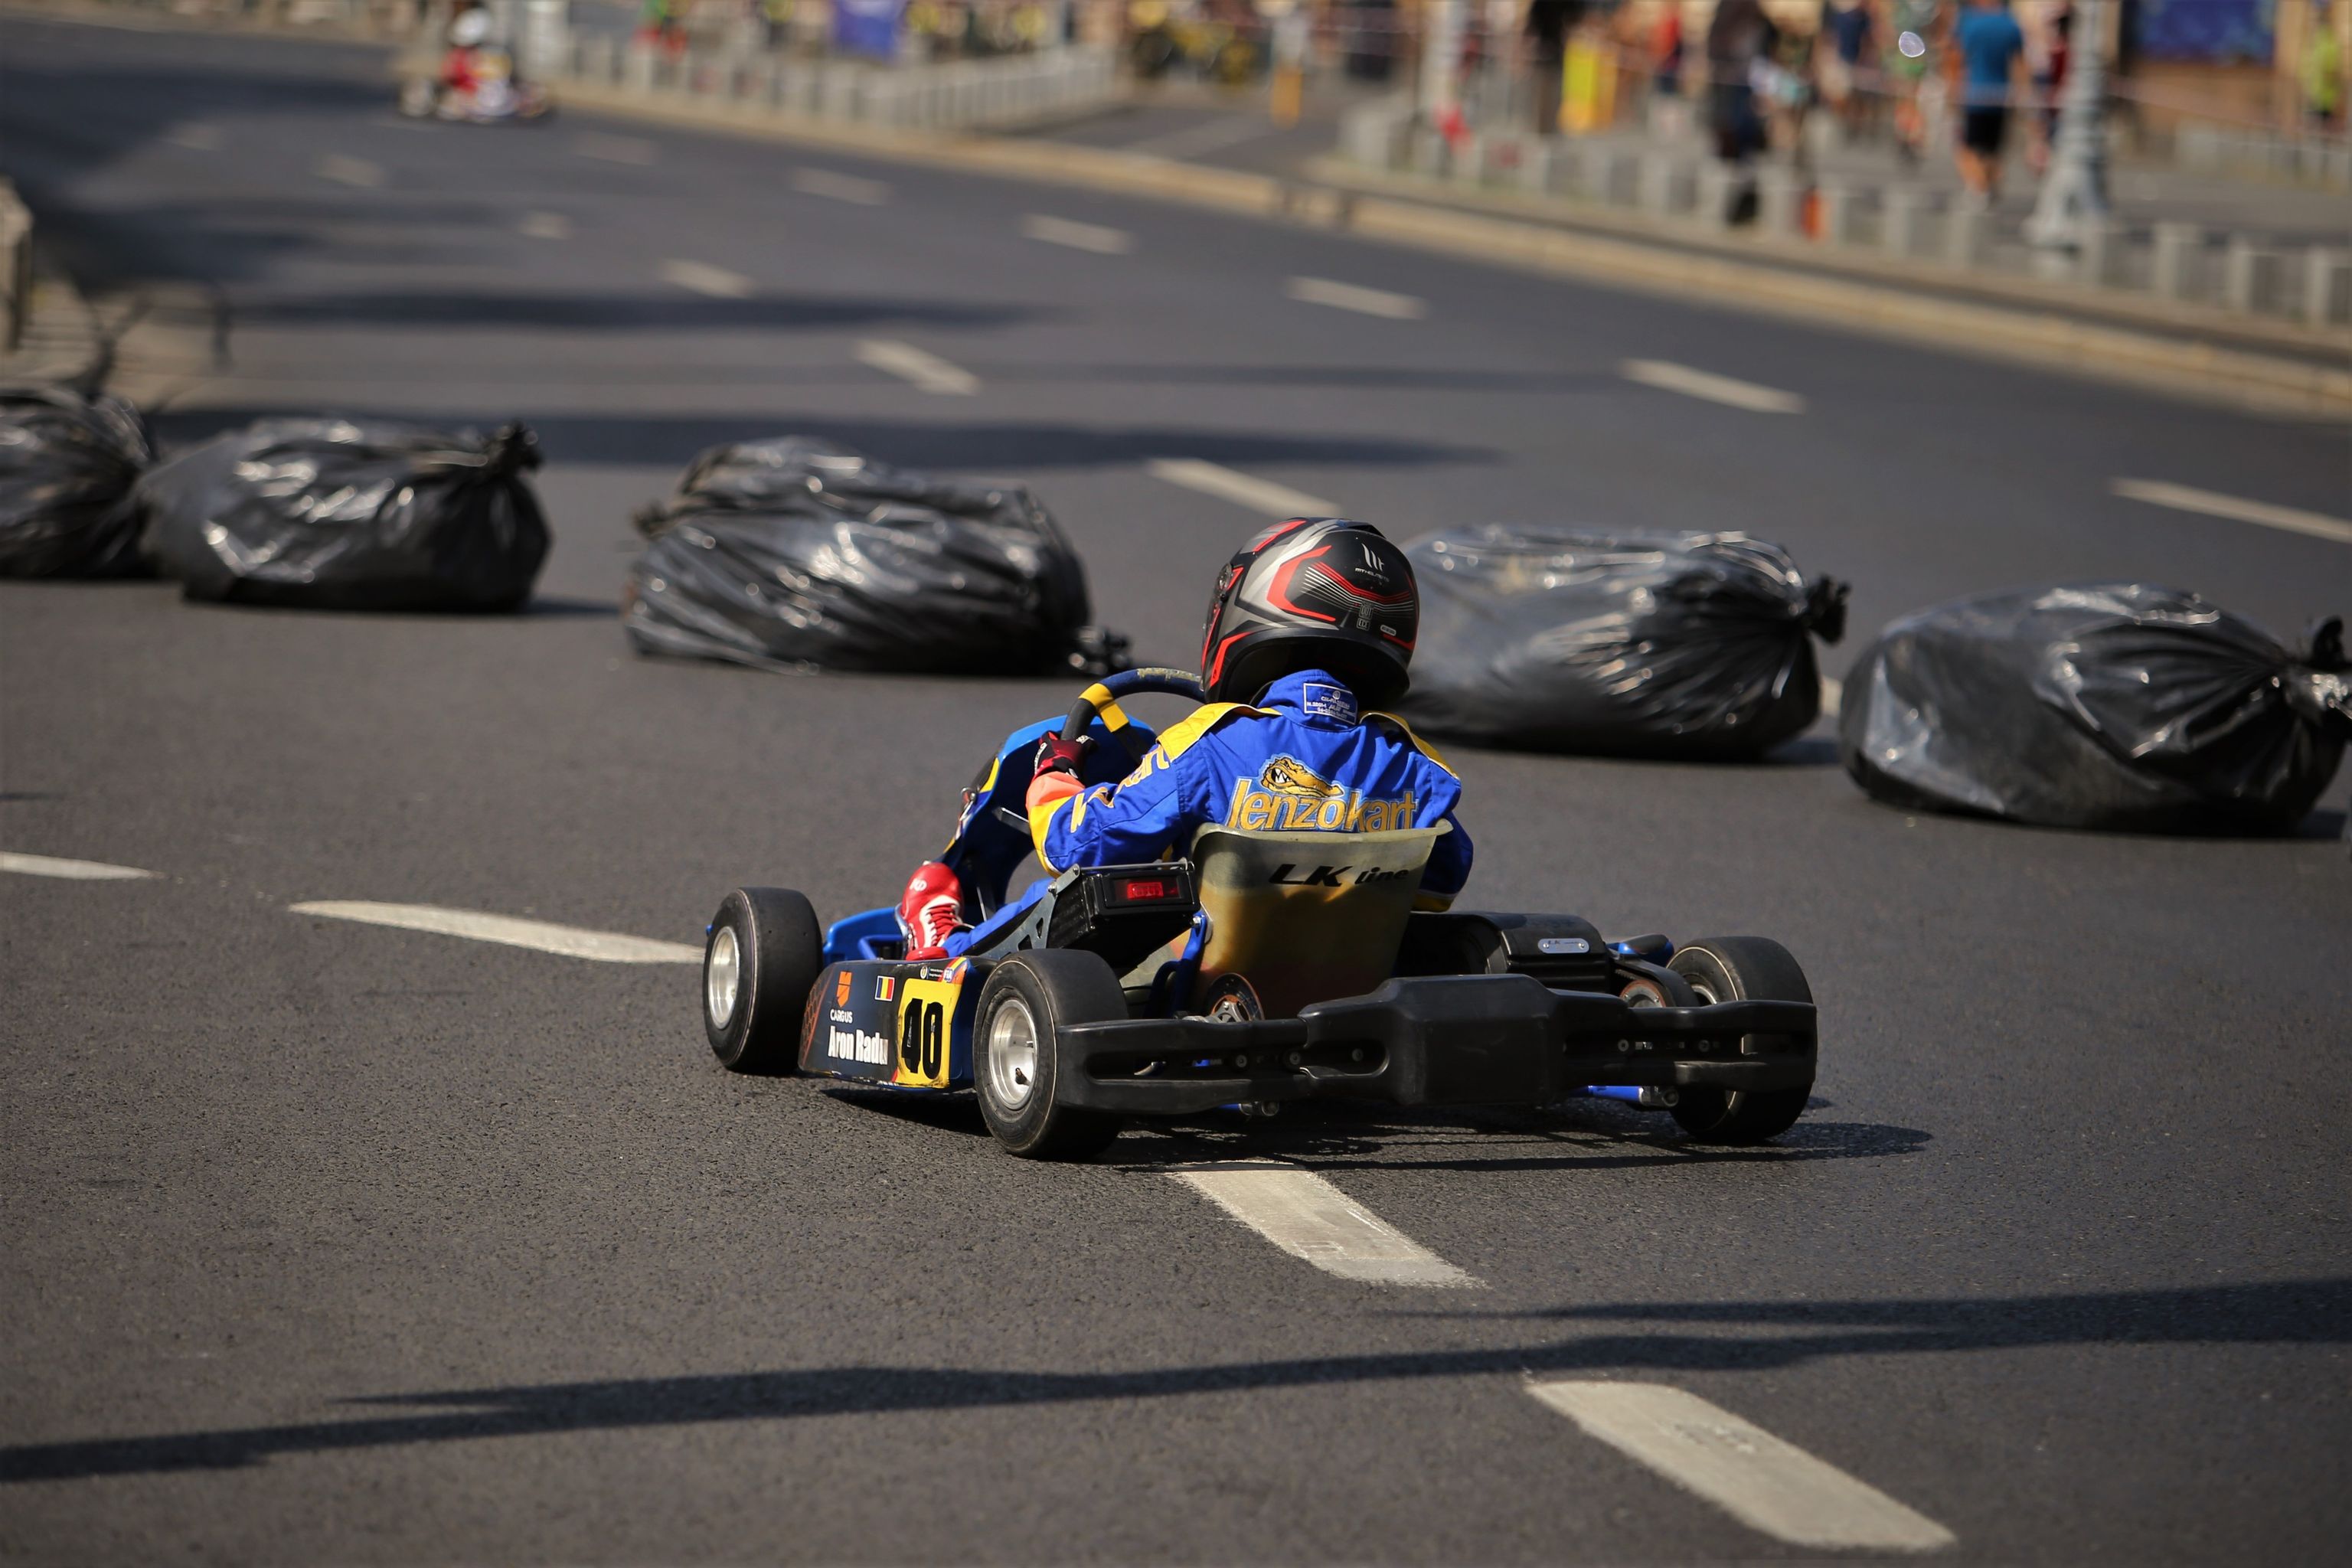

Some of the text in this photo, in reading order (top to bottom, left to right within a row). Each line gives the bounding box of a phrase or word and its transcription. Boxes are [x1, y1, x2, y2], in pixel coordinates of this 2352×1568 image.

[1226, 776, 1419, 832] lenzokart
[1269, 864, 1410, 887] LK line
[830, 1009, 853, 1024] CARGUS
[828, 1025, 854, 1060] Aron
[855, 1029, 889, 1065] Radu
